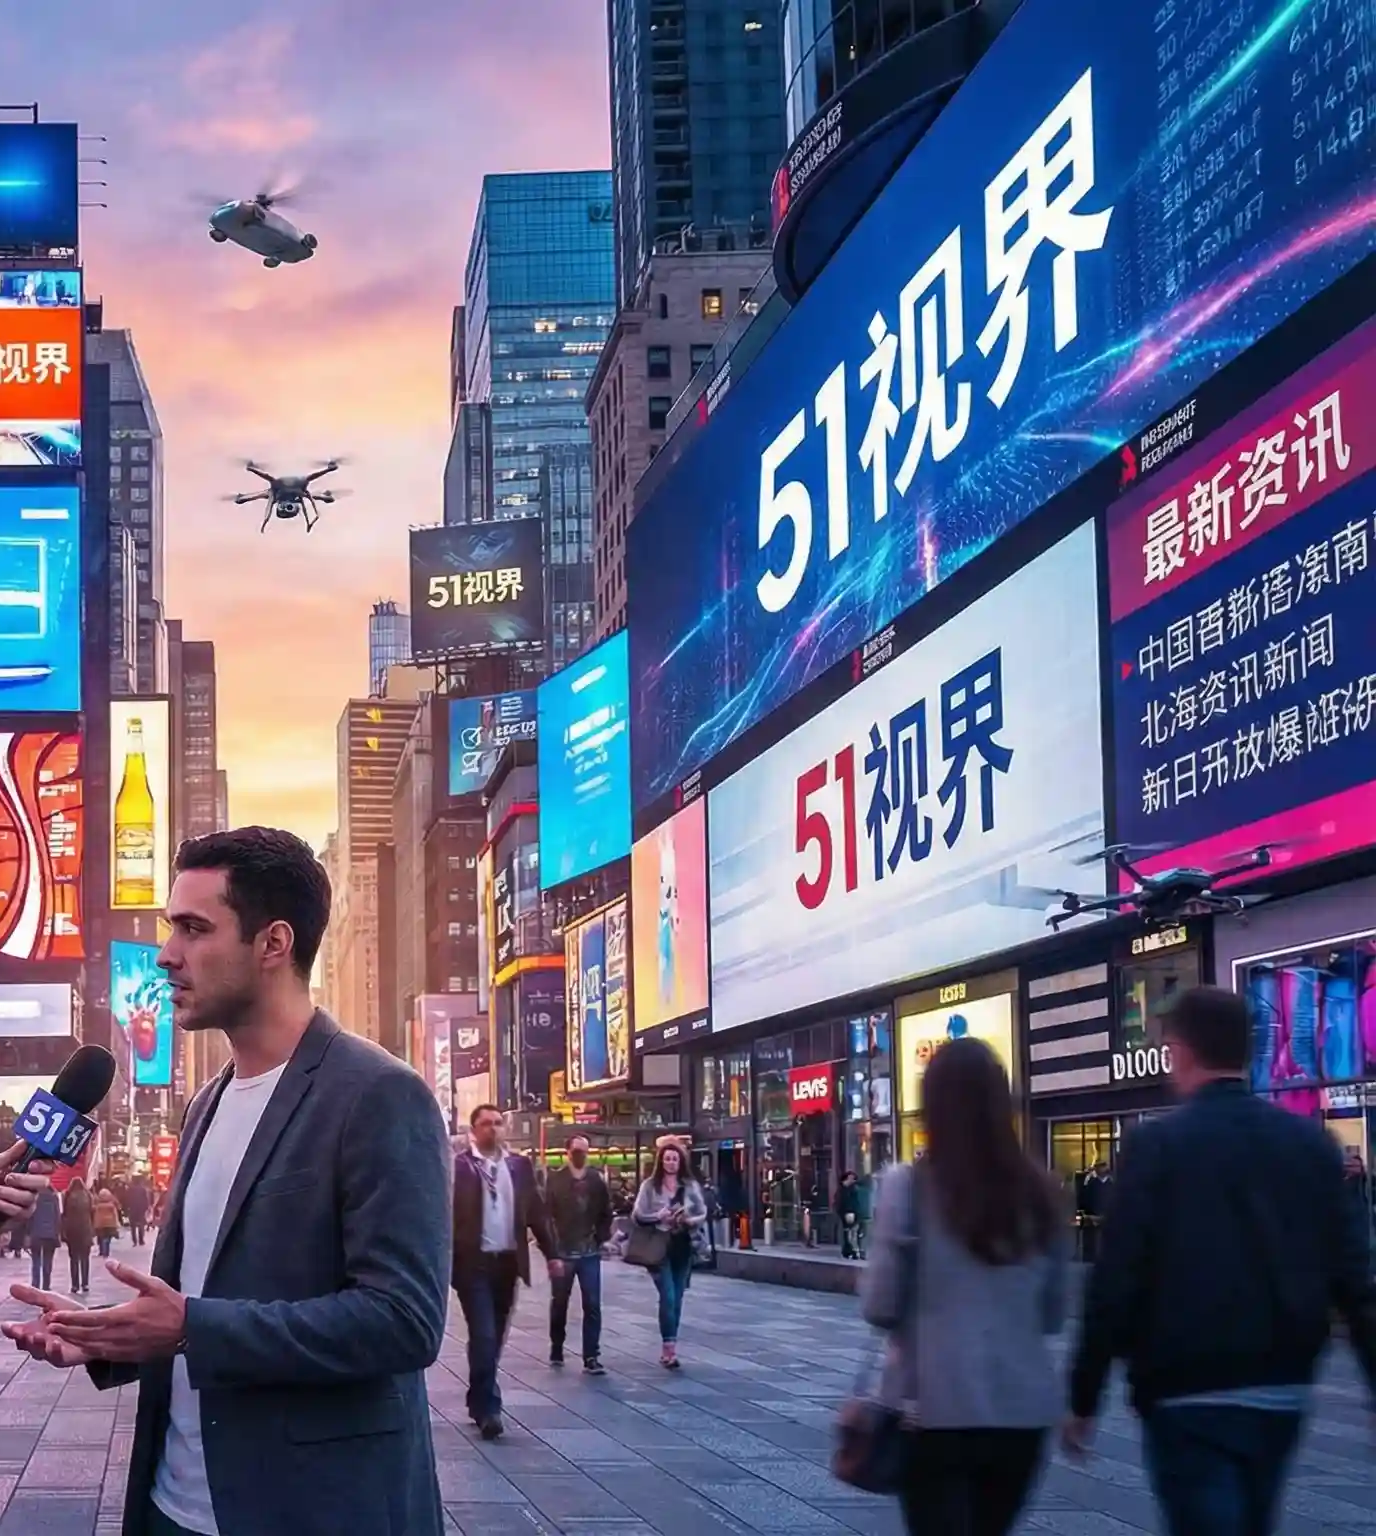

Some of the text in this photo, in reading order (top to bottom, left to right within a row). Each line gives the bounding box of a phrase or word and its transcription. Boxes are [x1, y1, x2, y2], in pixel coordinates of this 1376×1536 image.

[756, 66, 1114, 612] 51视界
[1143, 390, 1350, 585] 最新资讯
[427, 567, 524, 609] 51视界
[1140, 613, 1335, 748] 北海资讯新闻
[795, 646, 1014, 909] 51视界
[23, 1101, 65, 1143] 51
[60, 1124, 92, 1158] 51
